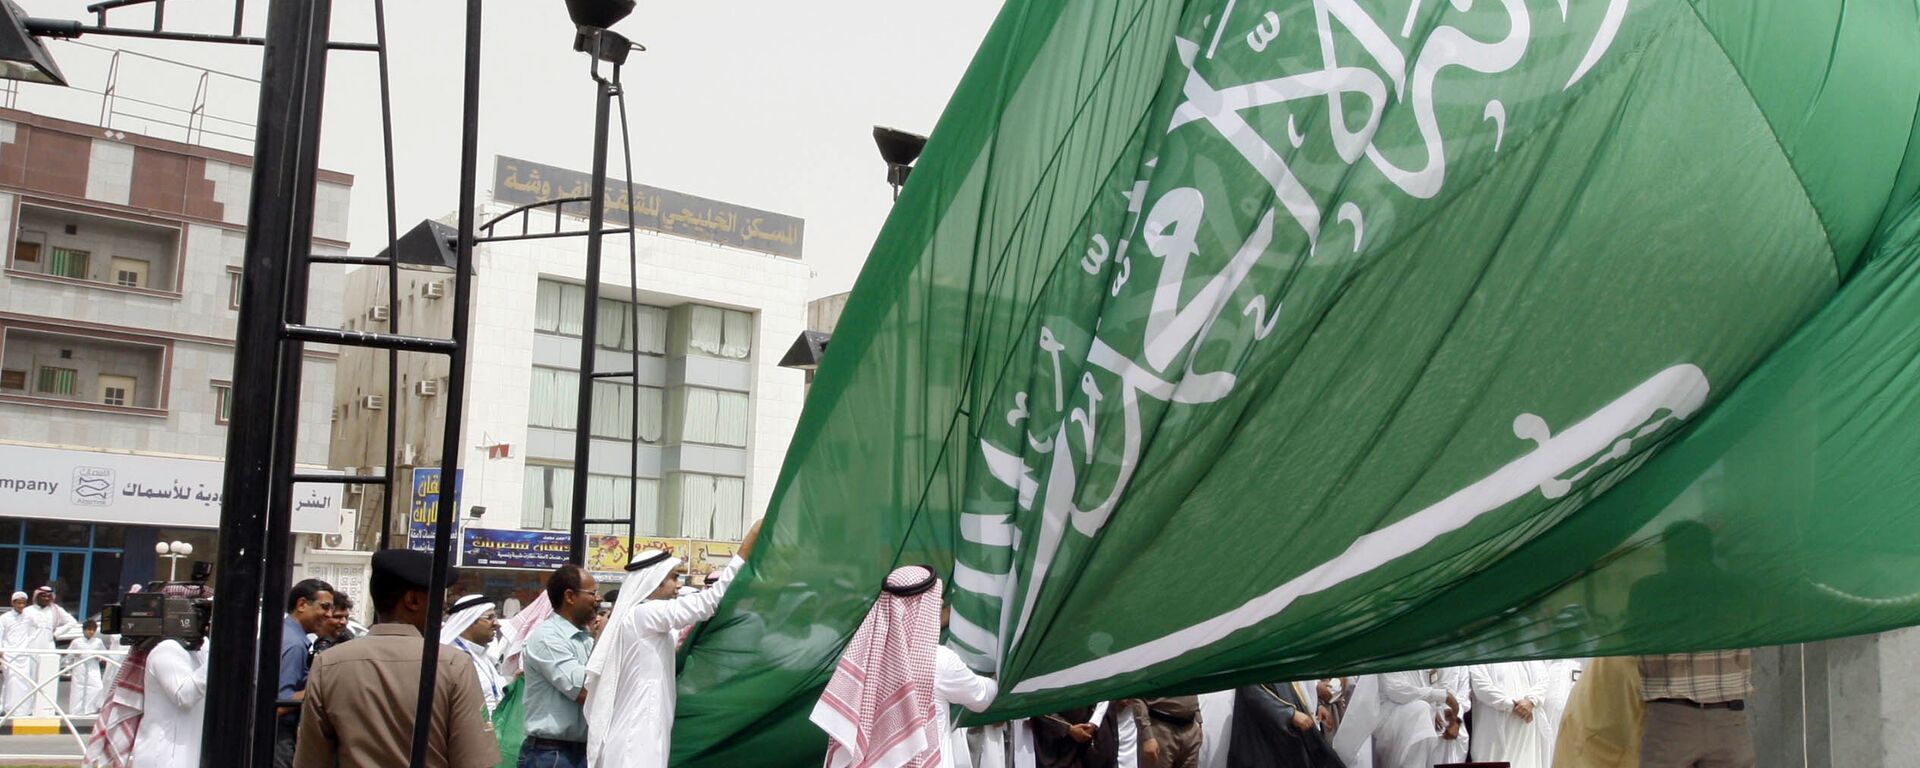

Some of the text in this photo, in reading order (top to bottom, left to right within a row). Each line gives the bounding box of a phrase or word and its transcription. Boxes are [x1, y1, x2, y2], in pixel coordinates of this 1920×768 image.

[662, 207, 737, 234] الخليجي
[0, 478, 59, 496] mpany
[122, 478, 192, 500] للأسماك
[295, 488, 332, 511] الشر
